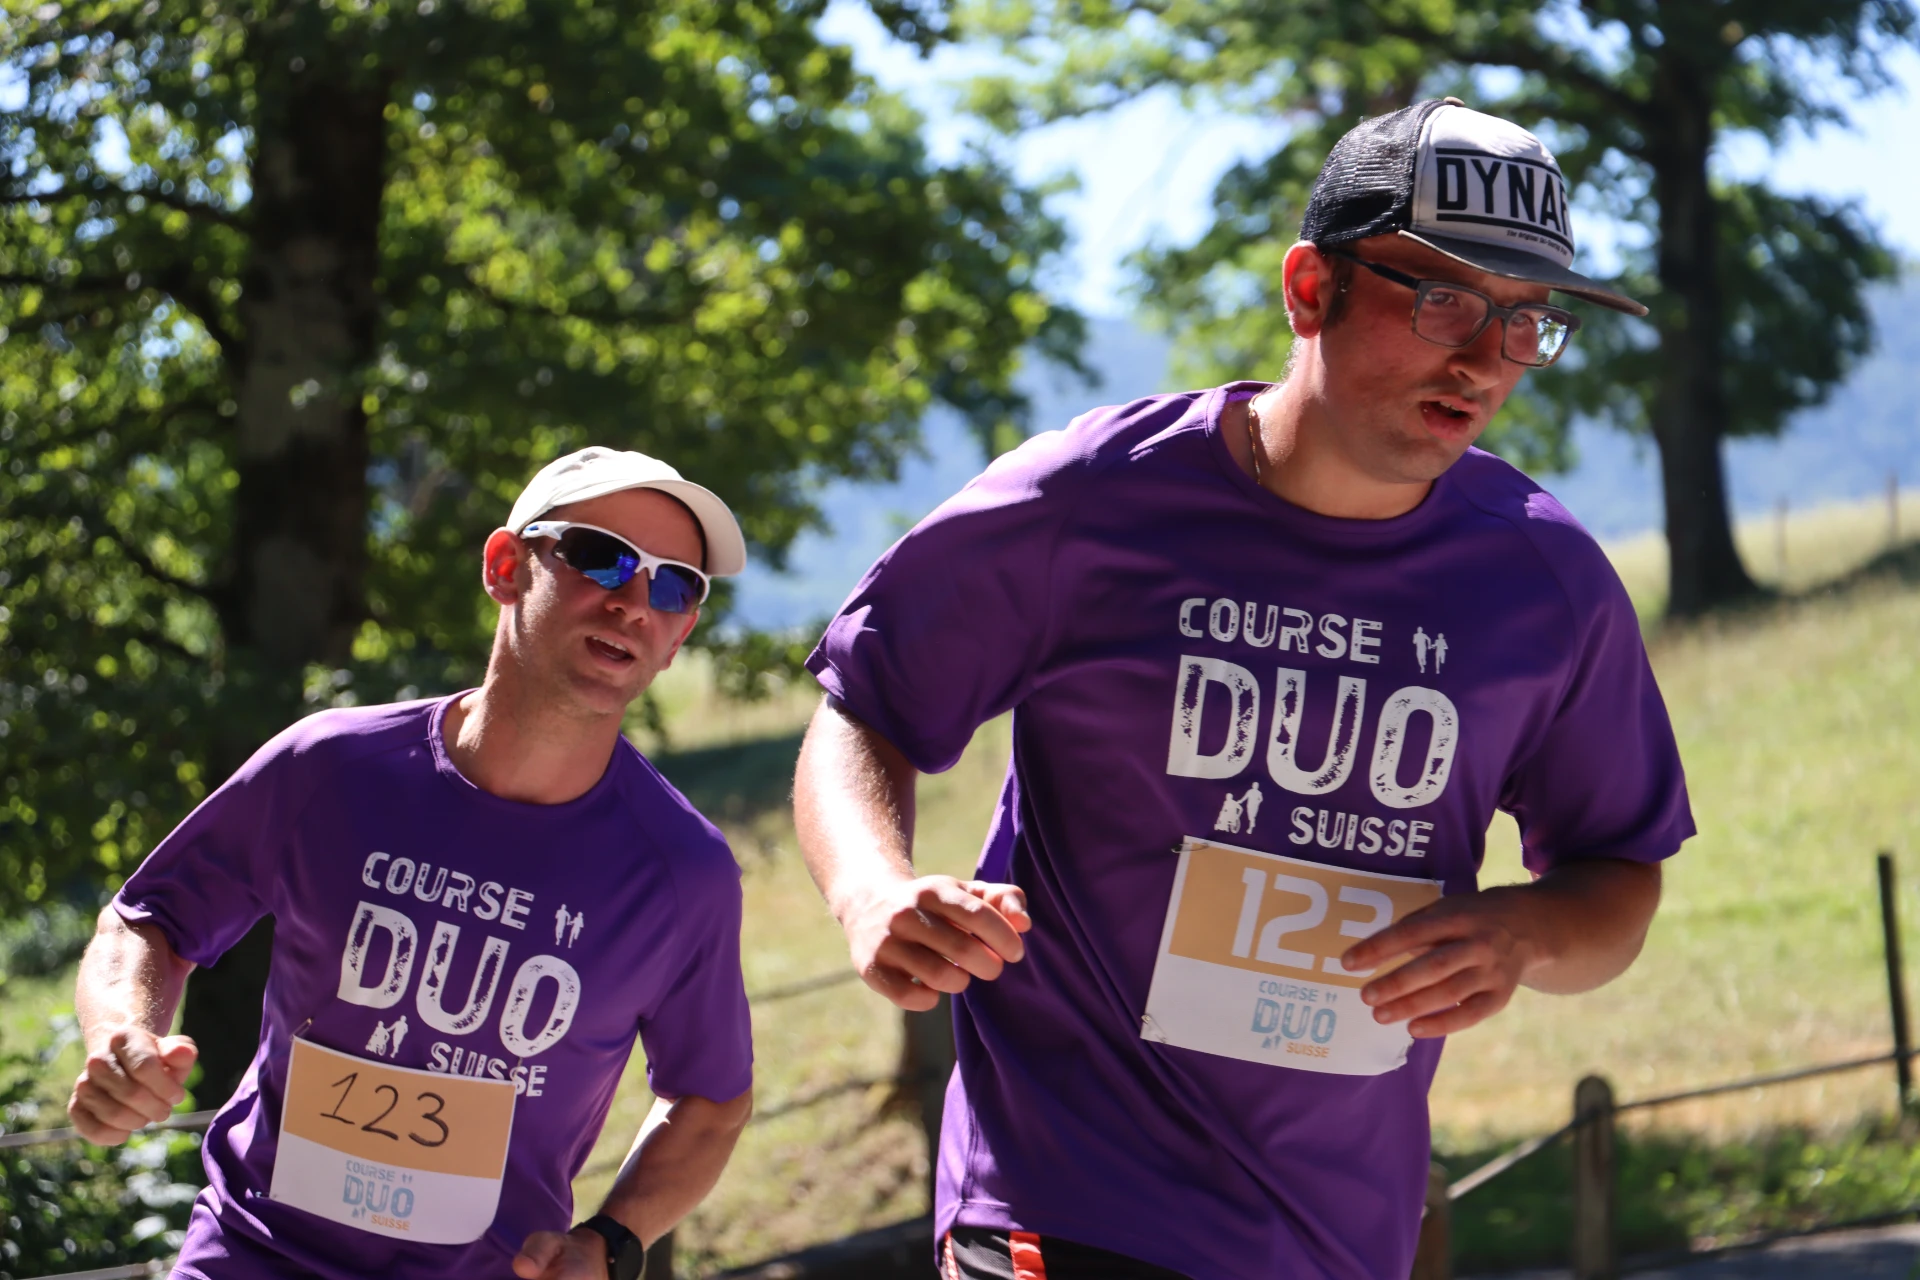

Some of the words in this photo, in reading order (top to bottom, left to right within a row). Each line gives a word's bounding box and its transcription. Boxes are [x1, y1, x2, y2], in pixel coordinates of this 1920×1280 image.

[1178, 597, 1383, 664] COURSE
[1166, 654, 1459, 809] DUO
[1288, 806, 1434, 858] SUISSE
[362, 851, 535, 930] COURSE
[1231, 867, 1394, 978] 123
[336, 900, 581, 1058] DUO
[1259, 980, 1318, 1002] COURSE
[1251, 997, 1337, 1044] DUO
[426, 1041, 548, 1097] SUISSE
[1286, 1041, 1330, 1059] SUISSE
[320, 1072, 449, 1147] 123
[342, 1174, 415, 1218] DUO
[346, 1159, 395, 1182] COURSE
[370, 1214, 410, 1231] SUISSE
